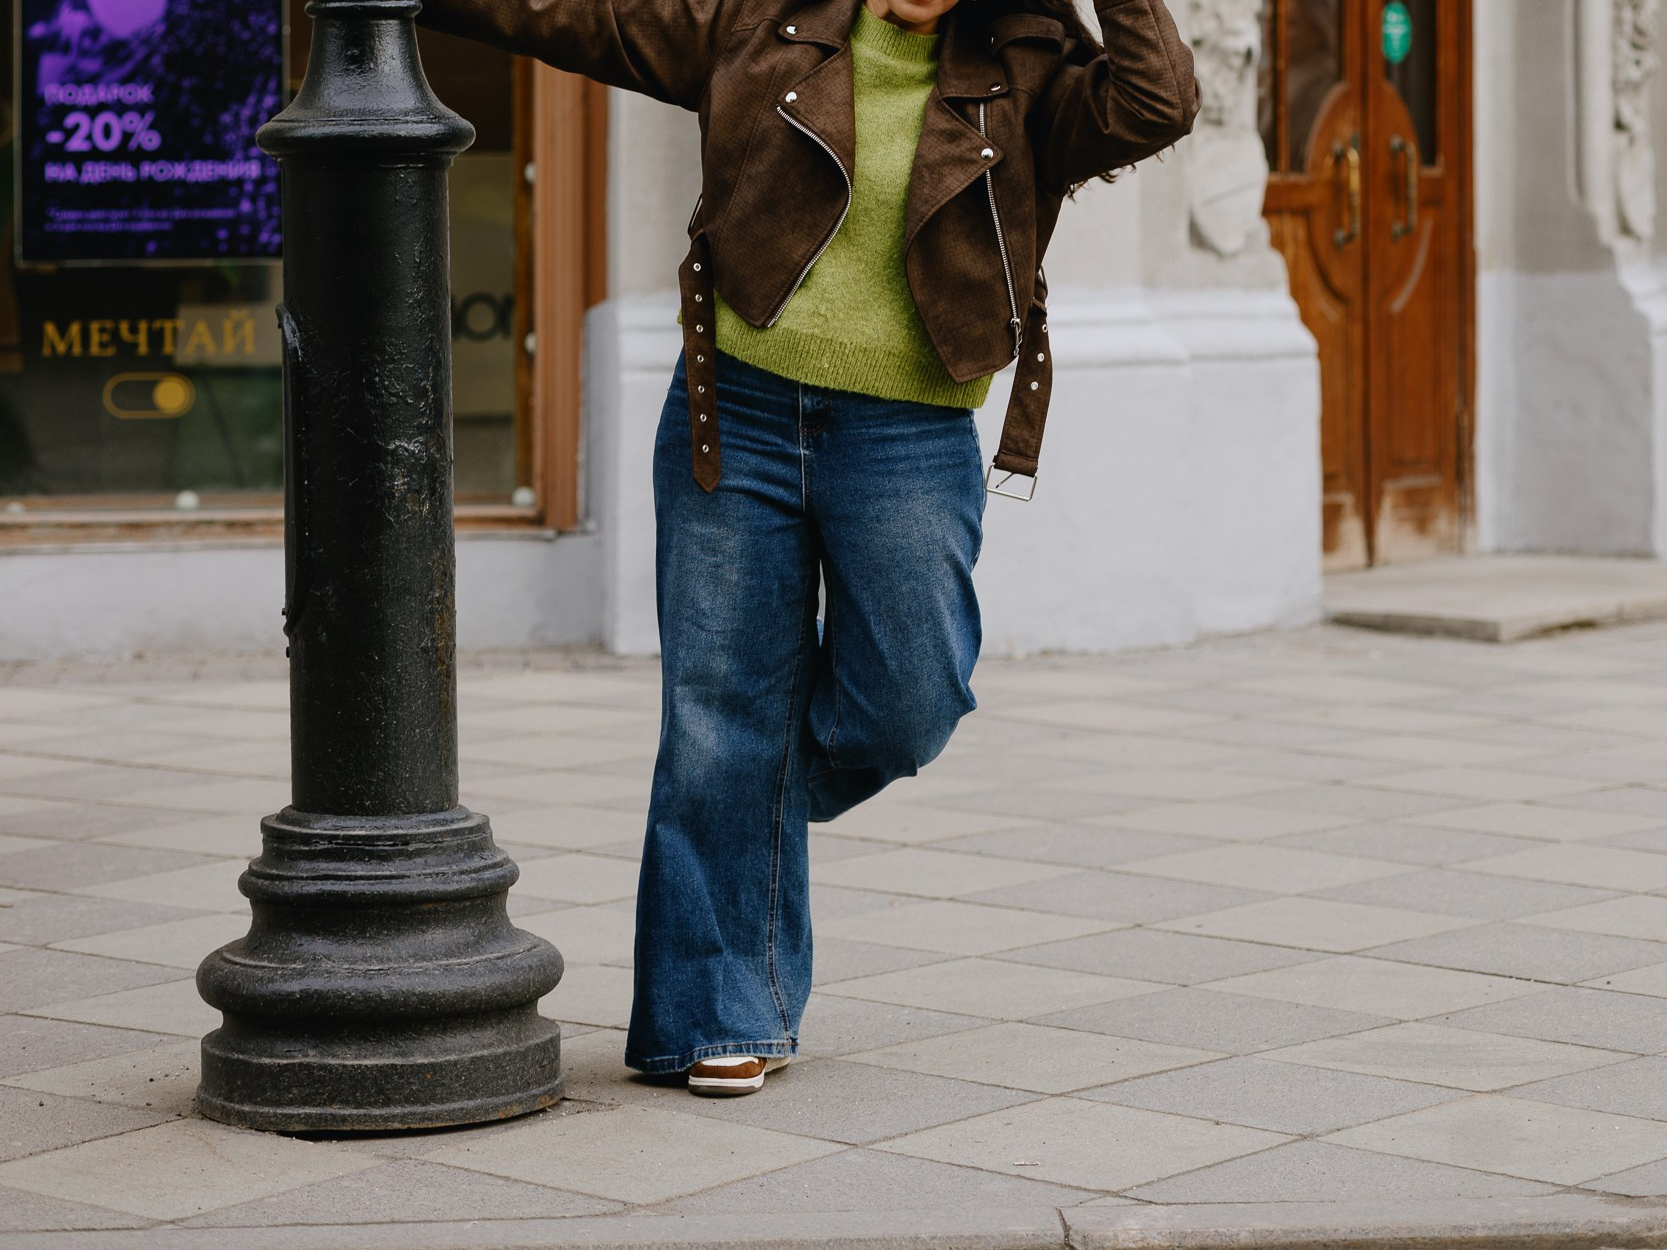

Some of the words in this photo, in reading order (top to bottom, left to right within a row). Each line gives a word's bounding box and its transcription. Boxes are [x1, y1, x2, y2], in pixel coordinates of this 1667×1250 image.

[45, 84, 154, 105] ПОДАРОК
[46, 111, 161, 151] -20%
[45, 162, 78, 182] НА
[80, 161, 137, 184] ДЕНЬ
[139, 160, 262, 183] РОЖДЕНИЯ
[42, 310, 256, 357] МЕЧТАЙ
